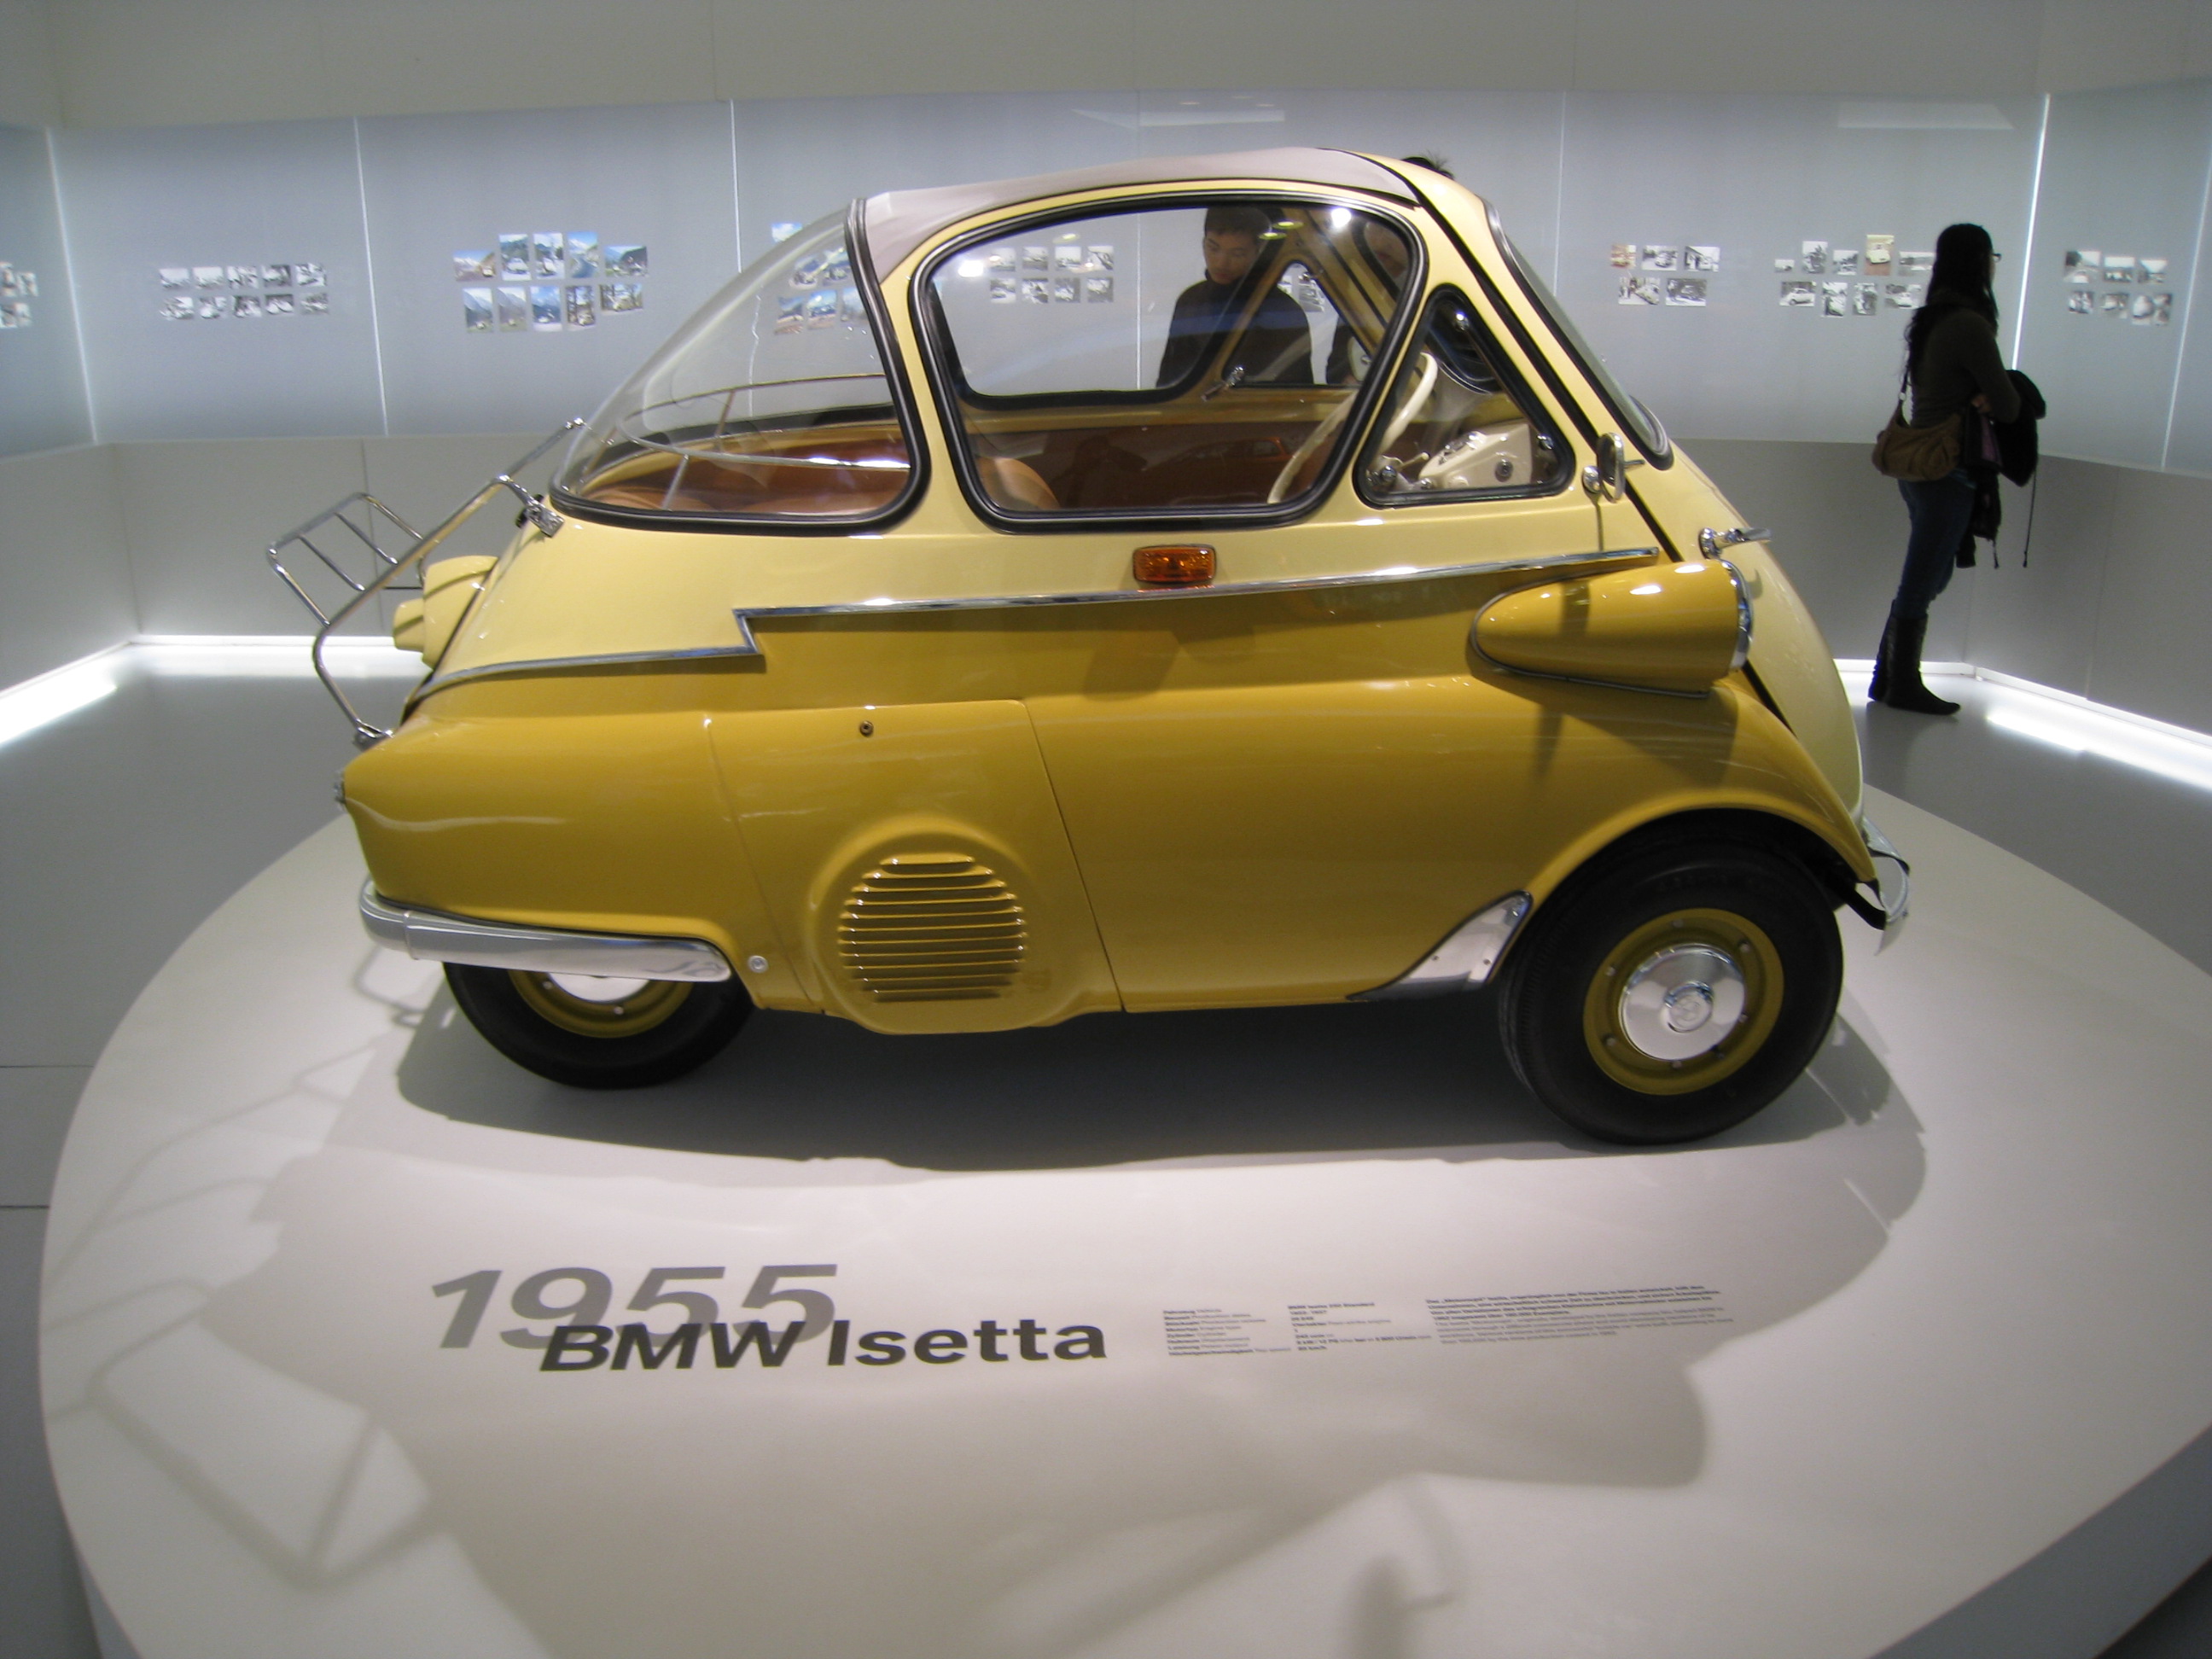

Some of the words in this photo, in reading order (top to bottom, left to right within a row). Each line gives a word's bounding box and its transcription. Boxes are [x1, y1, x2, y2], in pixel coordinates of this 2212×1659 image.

[431, 1264, 837, 1349] 1955
[538, 1320, 806, 1371] BMW
[827, 1318, 1108, 1367] Isetta
